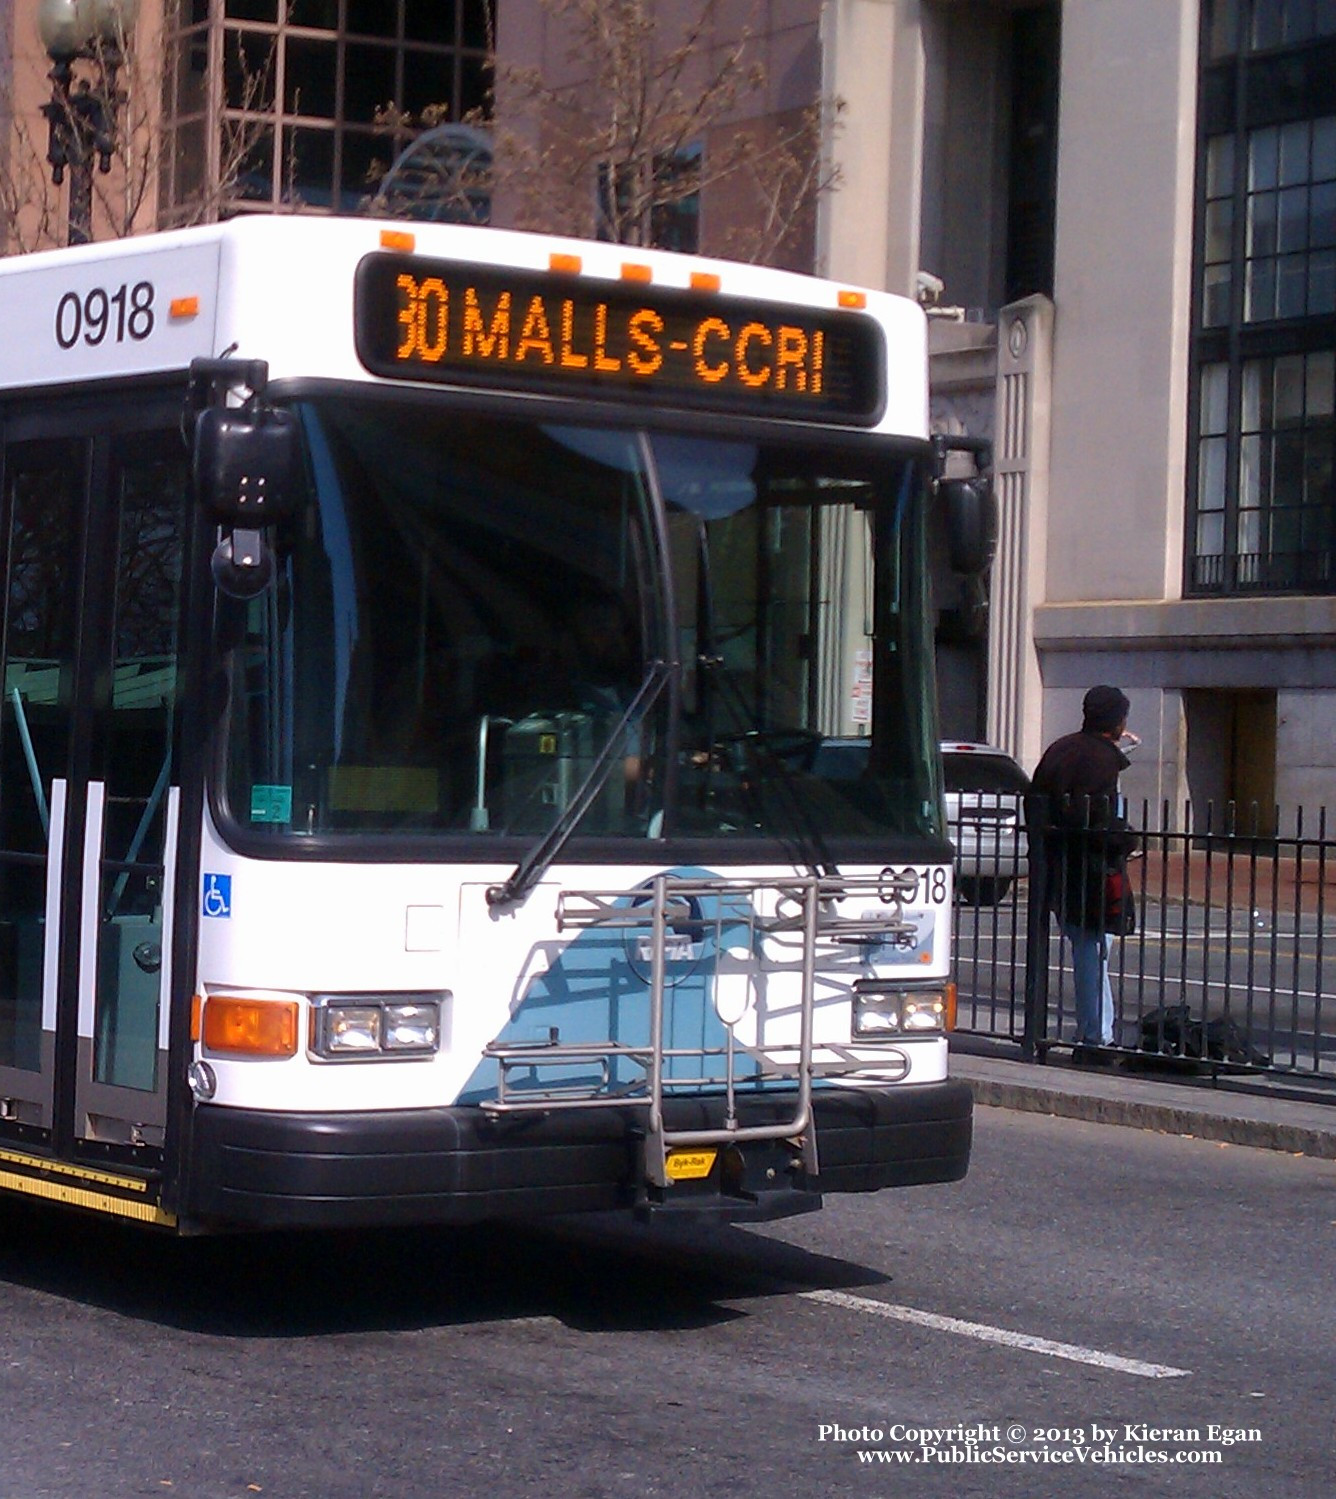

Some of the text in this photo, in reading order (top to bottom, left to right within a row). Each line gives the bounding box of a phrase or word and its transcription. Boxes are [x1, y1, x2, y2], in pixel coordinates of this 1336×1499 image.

[55, 280, 155, 350] 0918
[396, 273, 825, 395] 30 MALLS-CCRI
